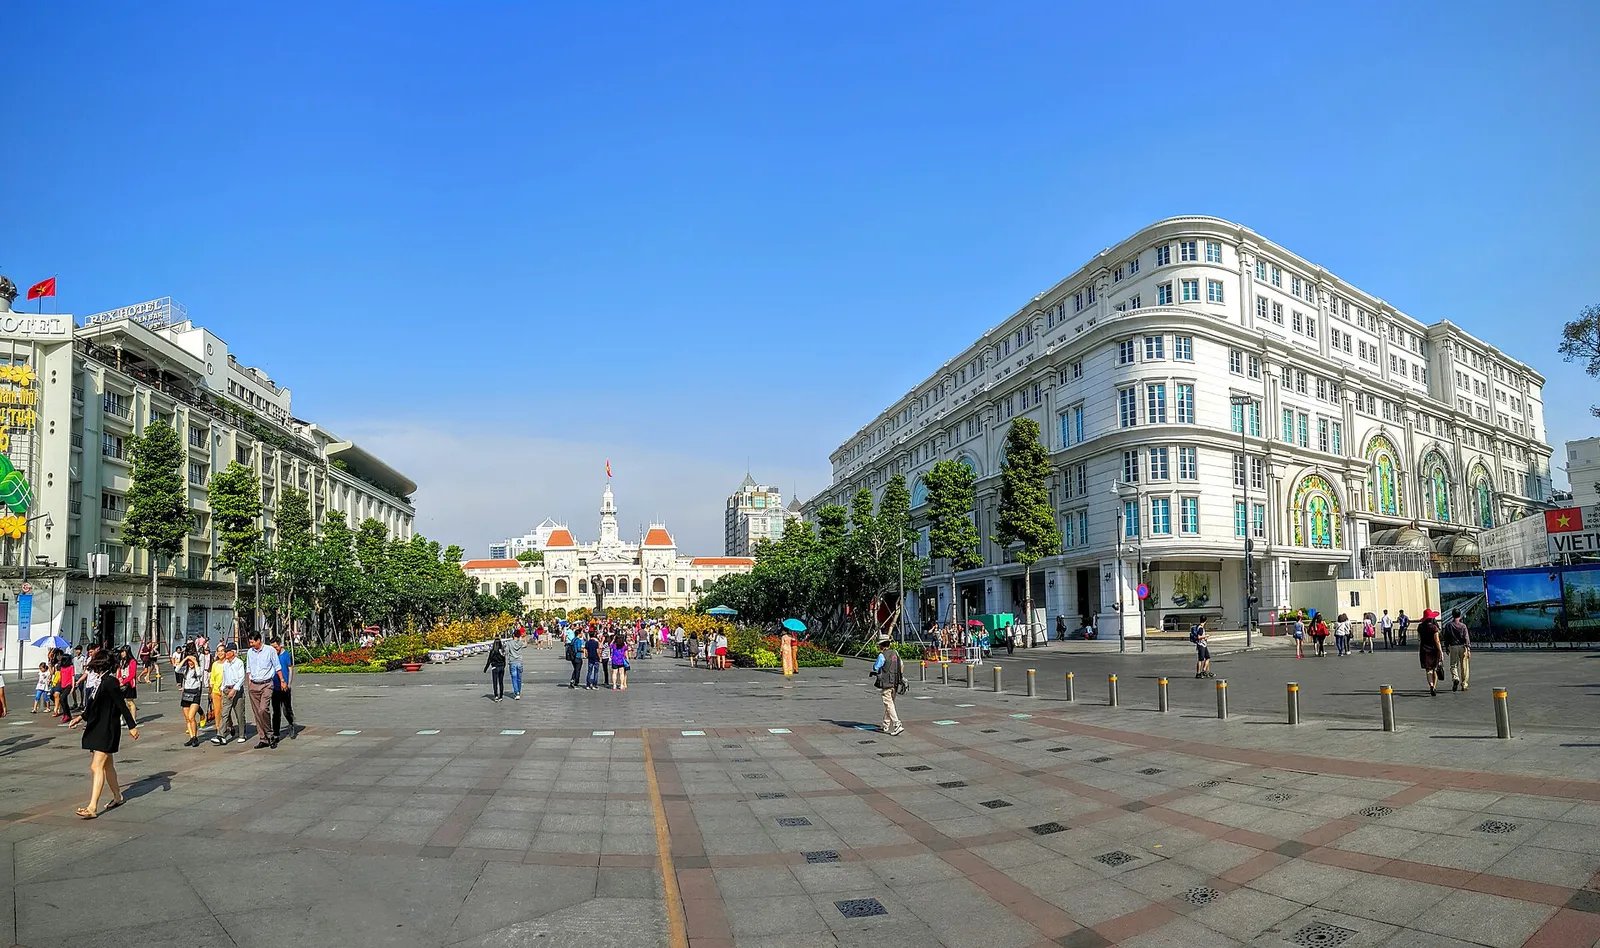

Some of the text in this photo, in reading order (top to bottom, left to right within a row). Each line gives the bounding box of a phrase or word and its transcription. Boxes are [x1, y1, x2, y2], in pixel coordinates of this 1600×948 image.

[89, 299, 163, 326] REX HOTEL
[0, 317, 65, 335] OTEL
